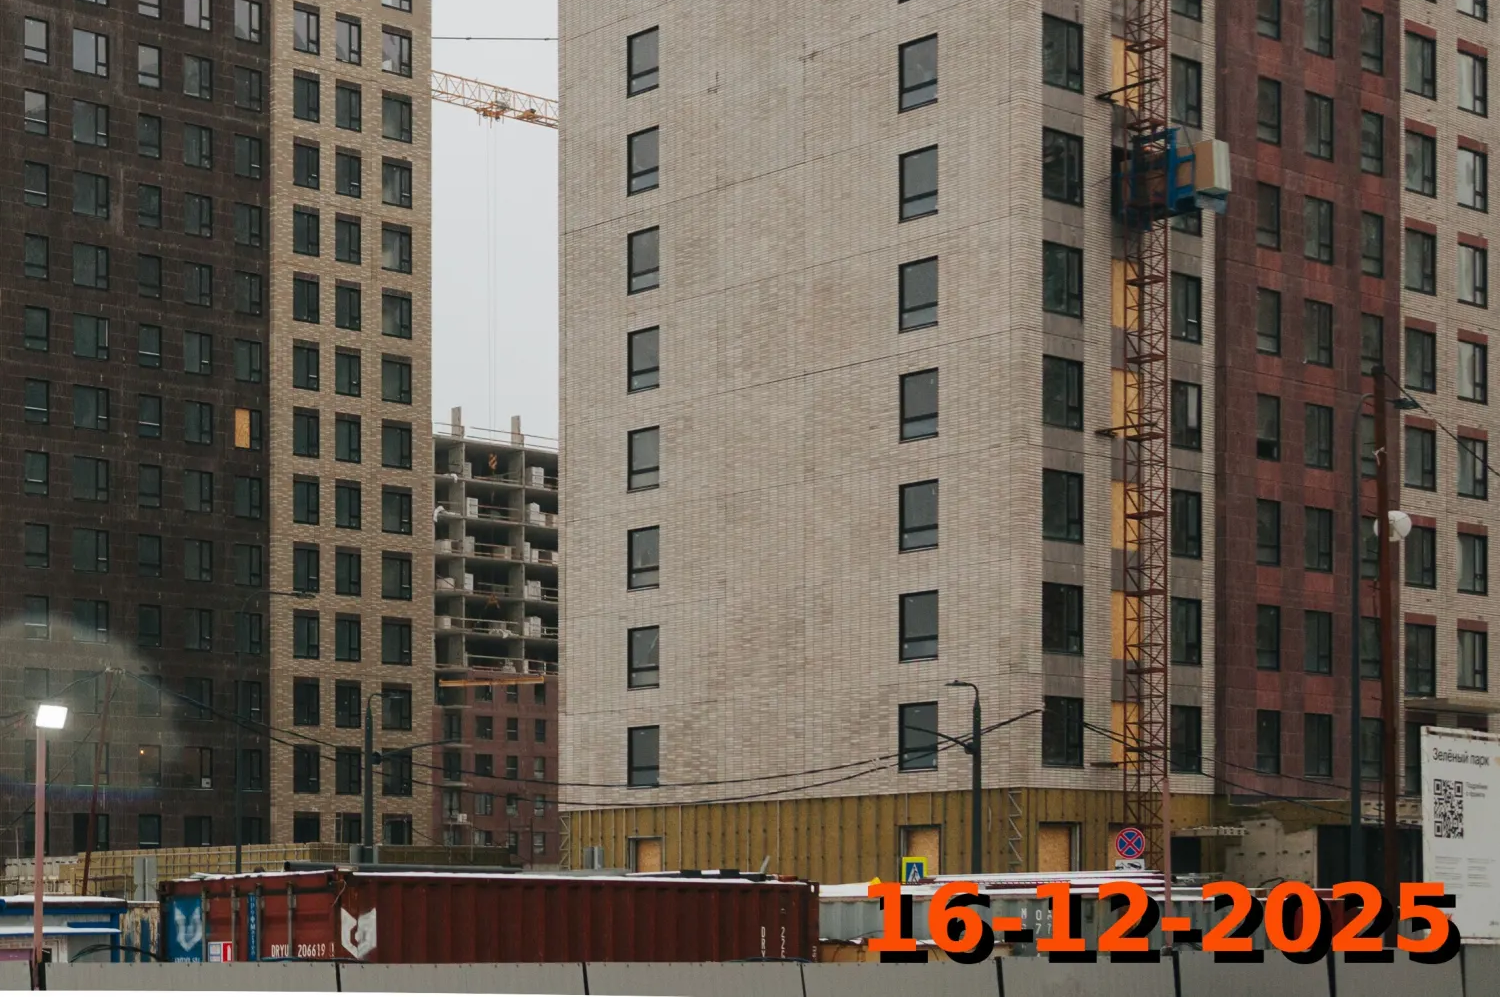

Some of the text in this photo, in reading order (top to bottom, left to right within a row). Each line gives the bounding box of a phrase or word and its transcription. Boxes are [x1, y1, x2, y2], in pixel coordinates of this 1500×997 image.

[1432, 747, 1490, 768] Зелёный парк
[271, 944, 290, 957] DRYU
[297, 943, 326, 957] 206619
